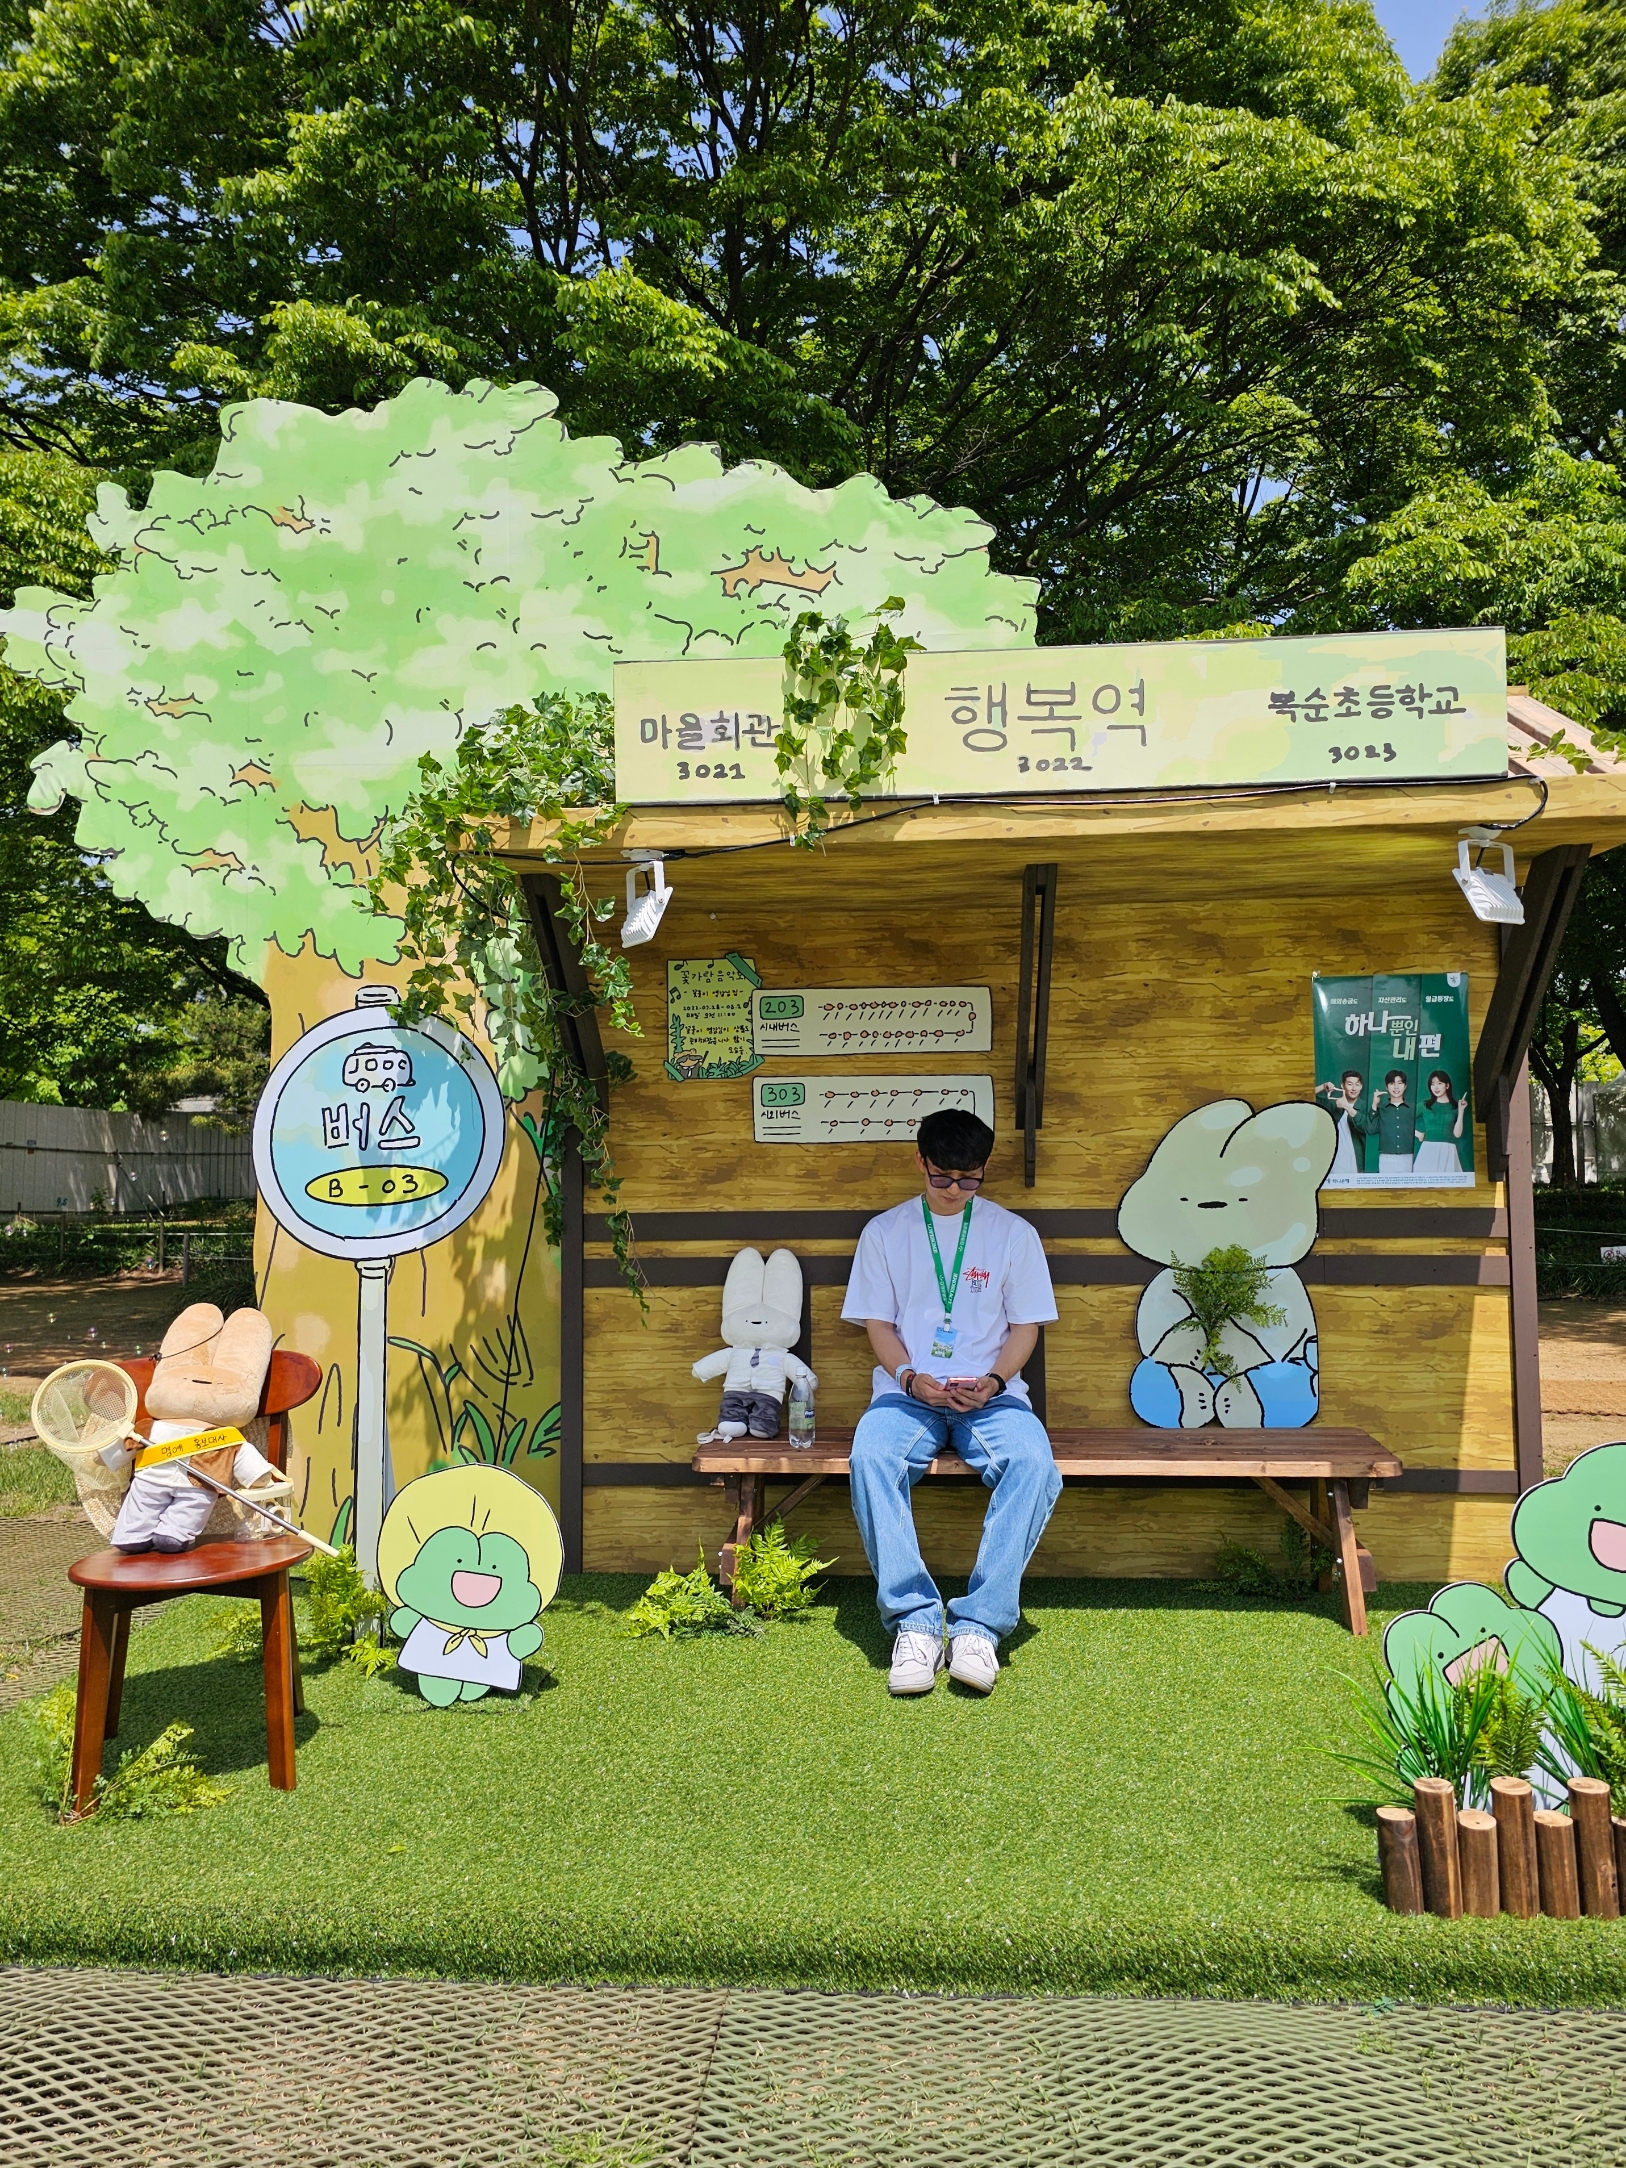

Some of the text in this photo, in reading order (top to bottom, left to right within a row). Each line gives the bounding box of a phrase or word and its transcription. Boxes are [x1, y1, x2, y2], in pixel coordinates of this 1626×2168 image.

[1267, 682, 1467, 723] 복순초등학교
[944, 678, 1147, 752] 행복역
[640, 710, 783, 751] 마을회관
[1328, 742, 1397, 764] 3023
[676, 761, 746, 780] 3021
[1017, 756, 1093, 774] 3022
[765, 999, 800, 1015] 203
[1378, 996, 1407, 1004] 자산관리도
[760, 1022, 800, 1033] 시내버스
[767, 1086, 801, 1102] 303
[322, 1095, 421, 1151] 버스
[761, 1109, 801, 1120] 시외버스
[194, 1433, 227, 1449] 홍보대사
